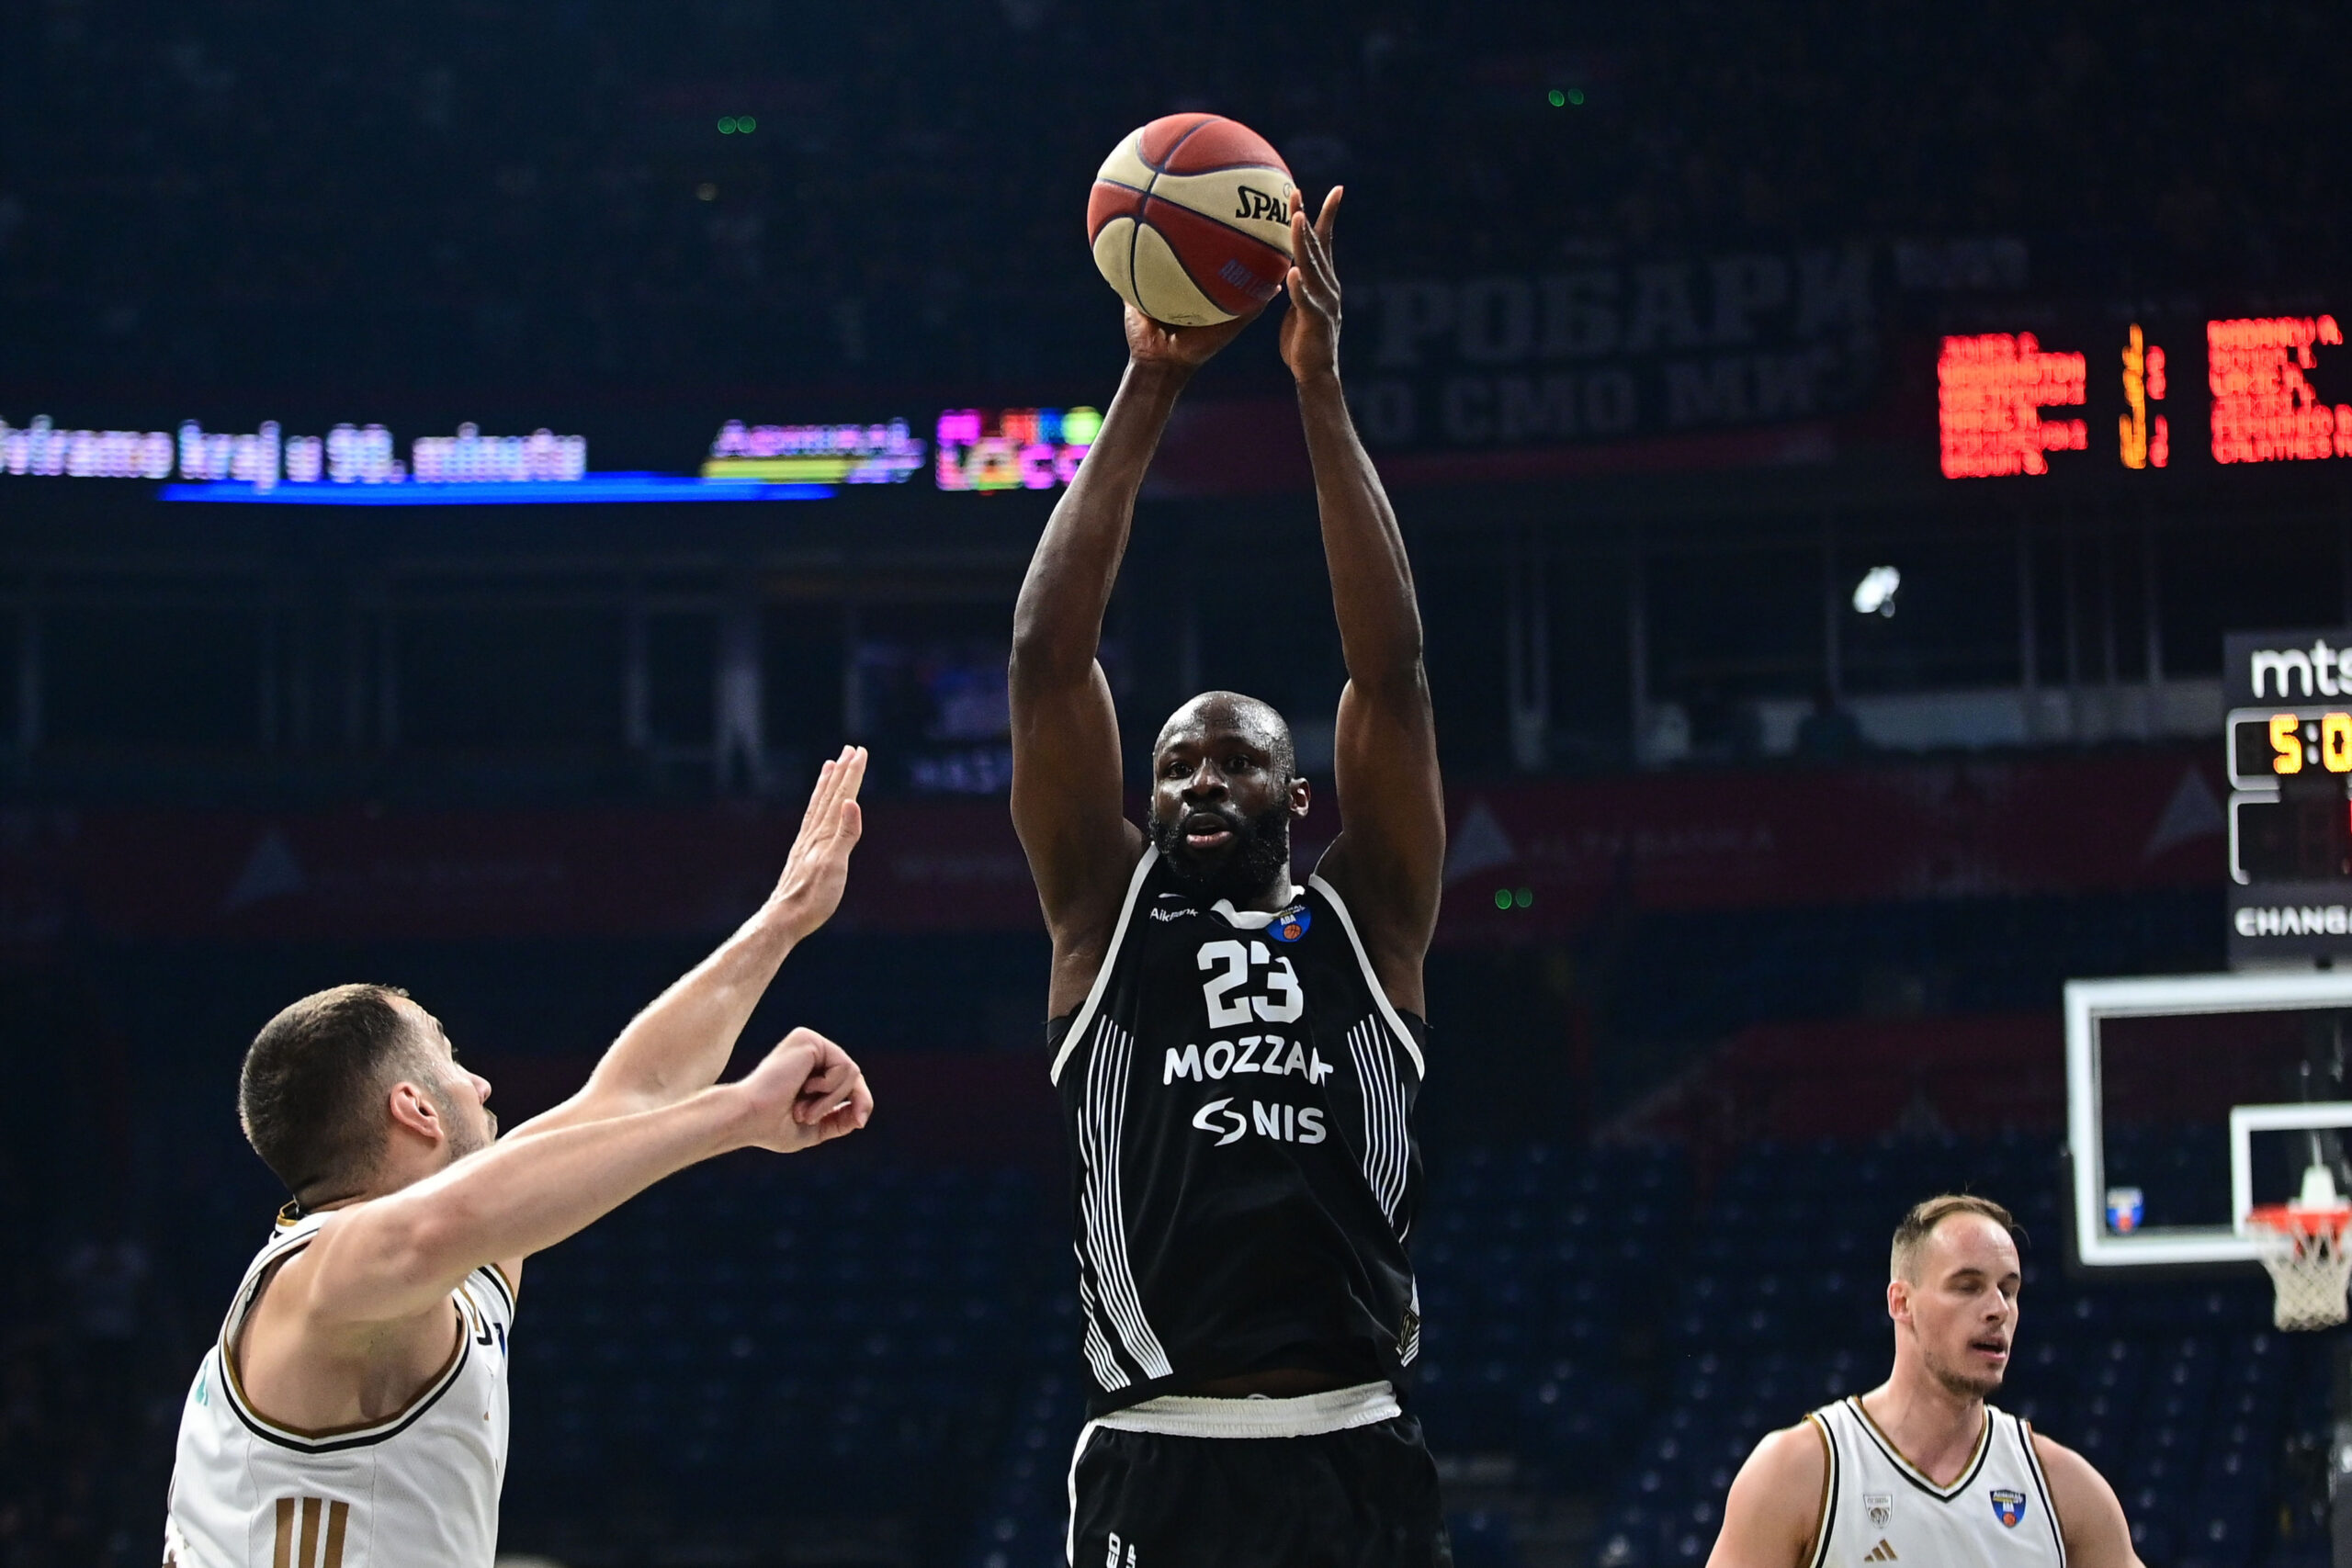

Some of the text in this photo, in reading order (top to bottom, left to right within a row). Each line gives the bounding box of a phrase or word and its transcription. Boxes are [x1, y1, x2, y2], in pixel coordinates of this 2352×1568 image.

[1343, 245, 1872, 368] РОБАРИ
[2234, 905, 2352, 936] CHANG
[1197, 940, 1304, 1029] 23
[1252, 1100, 1327, 1145] NIS
